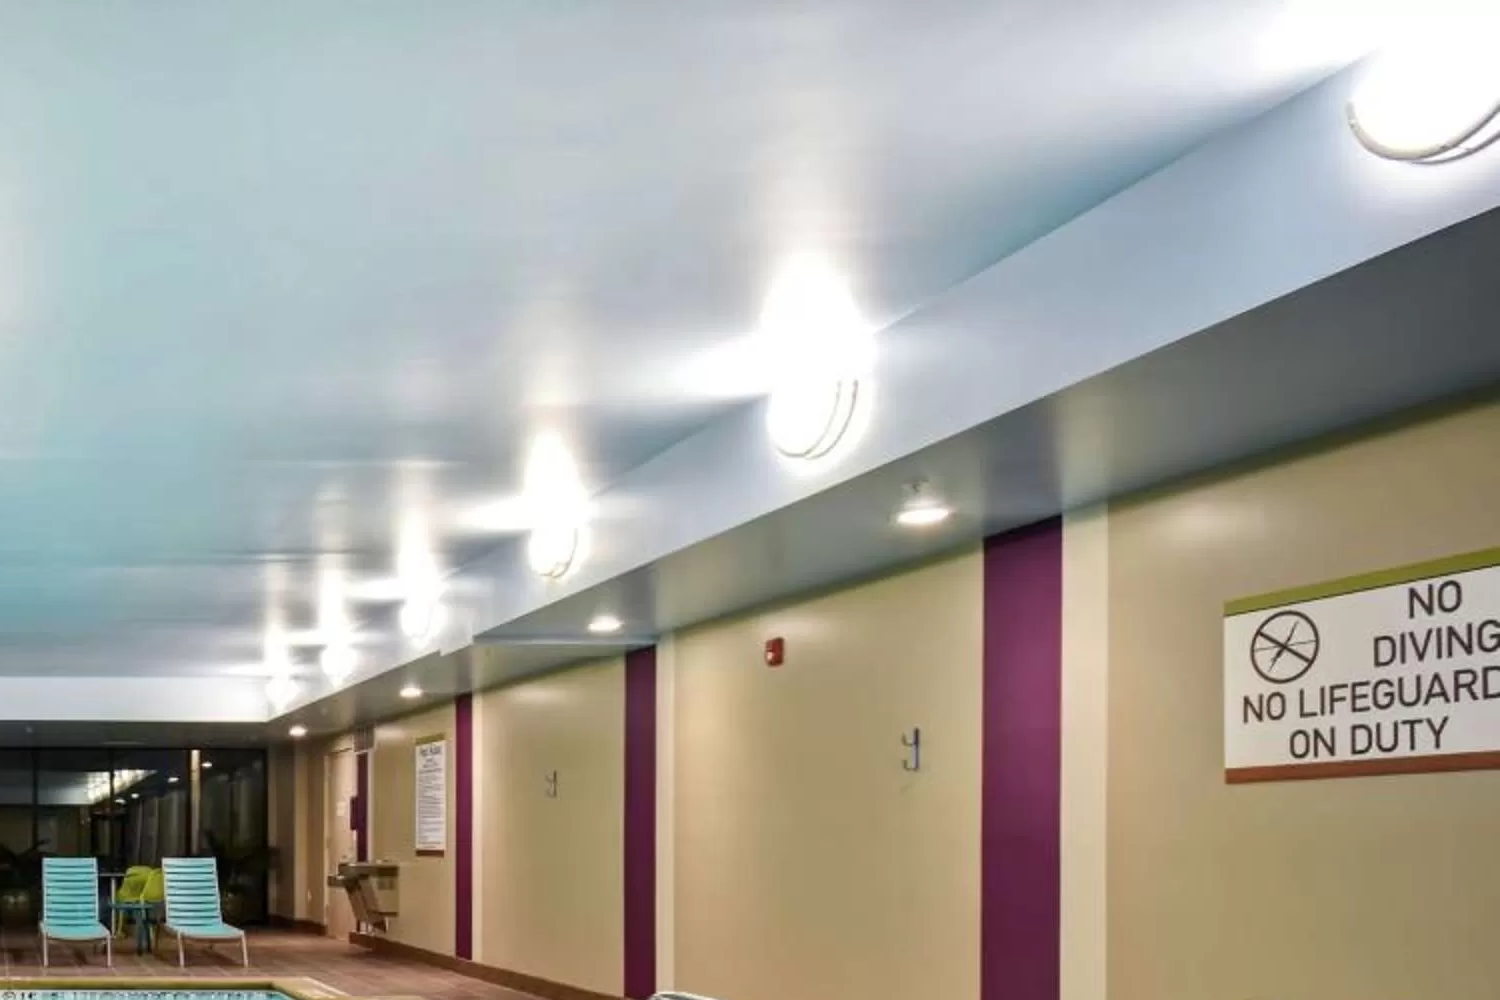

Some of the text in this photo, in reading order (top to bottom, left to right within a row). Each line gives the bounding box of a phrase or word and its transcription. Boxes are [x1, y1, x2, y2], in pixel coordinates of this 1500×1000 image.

[1408, 579, 1463, 619] NO
[1373, 619, 1500, 668] DIVING
[1243, 665, 1500, 724] NO LIFEGUARD
[1289, 715, 1449, 760] ON DUTY
